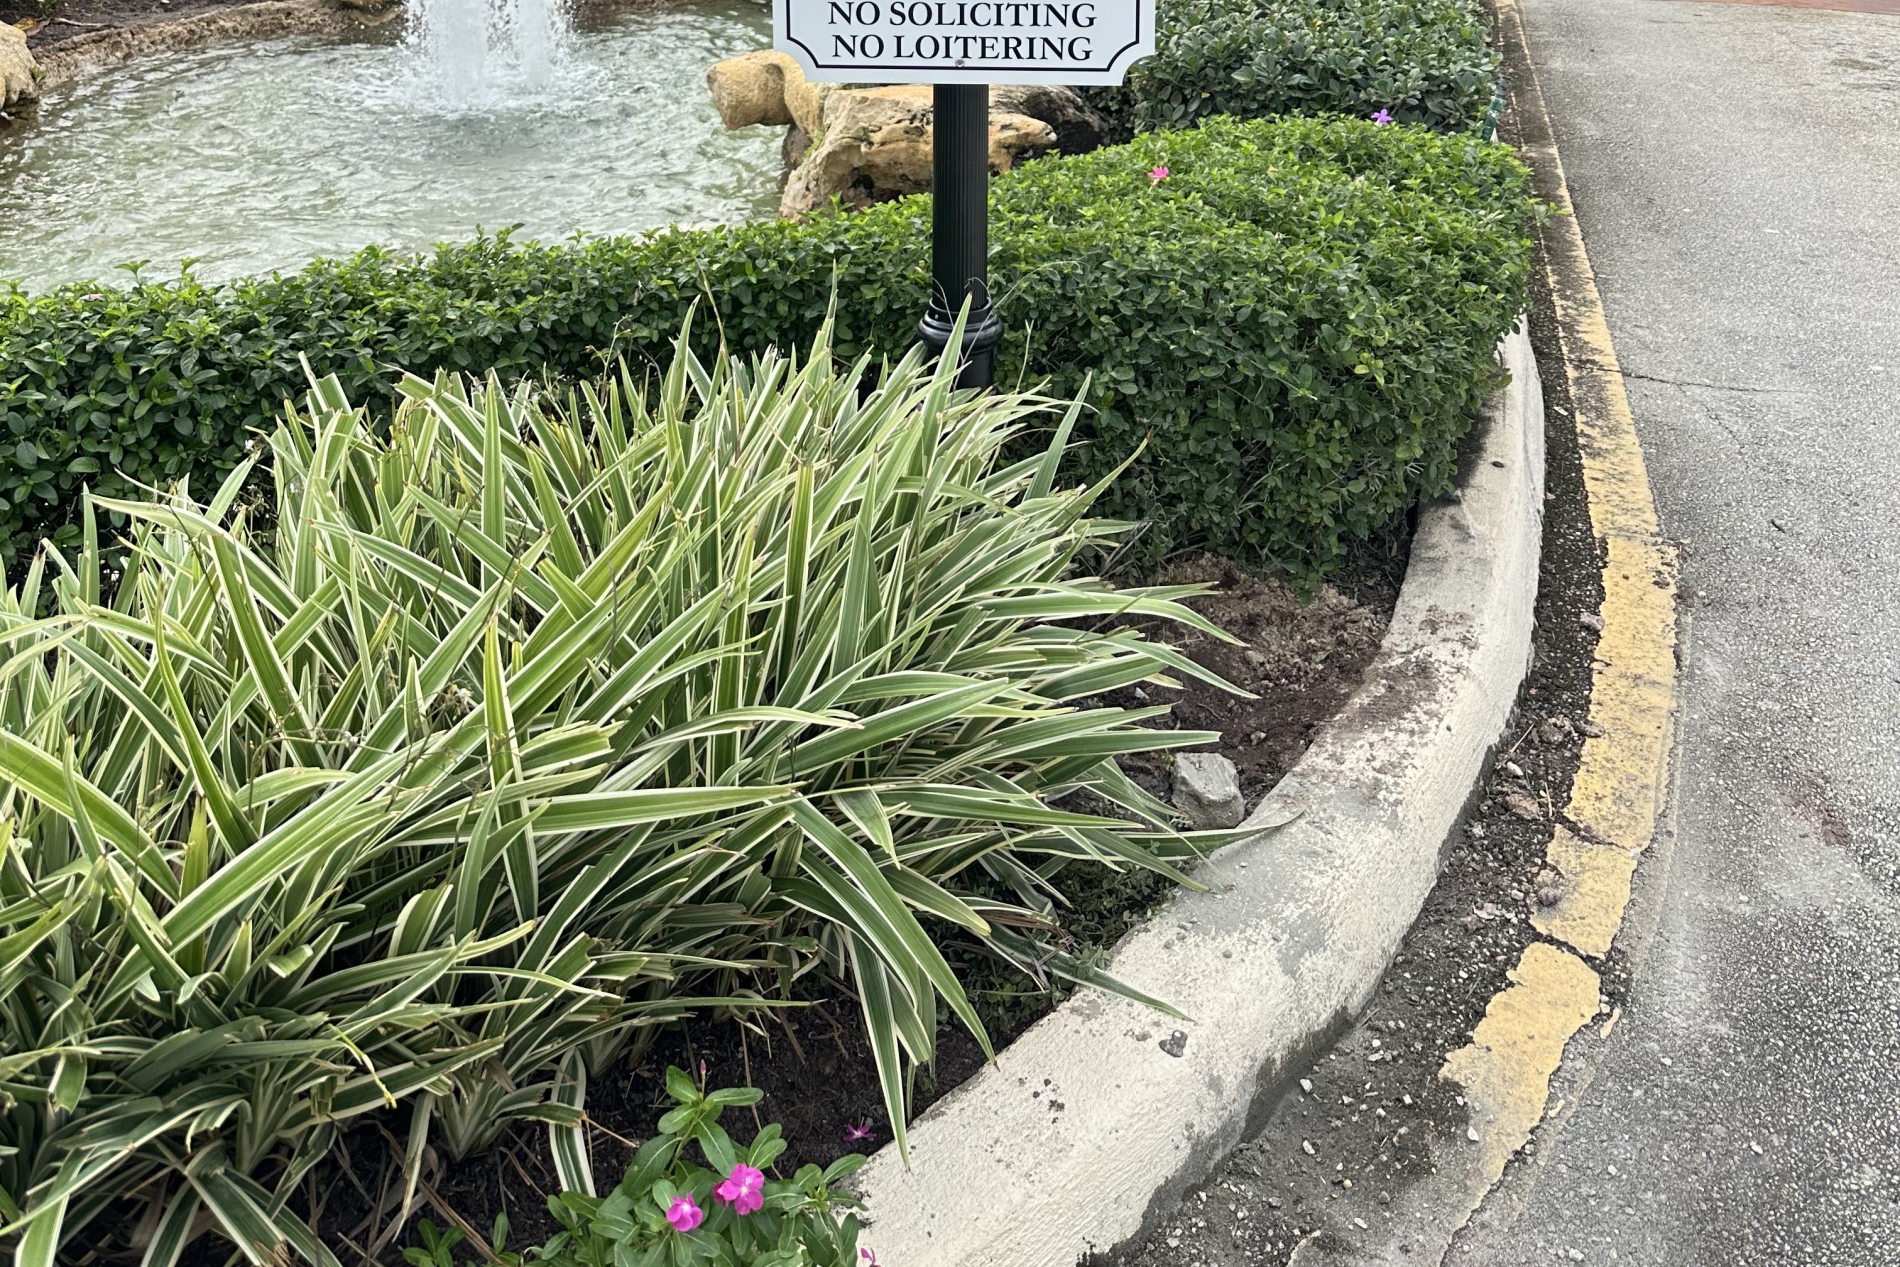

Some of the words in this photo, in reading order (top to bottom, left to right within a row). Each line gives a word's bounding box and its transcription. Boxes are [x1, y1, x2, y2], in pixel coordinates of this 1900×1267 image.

[828, 2, 880, 25] NO
[889, 2, 1097, 27] SOLICITING
[833, 35, 884, 58] NO
[893, 35, 1092, 60] LOITERING
